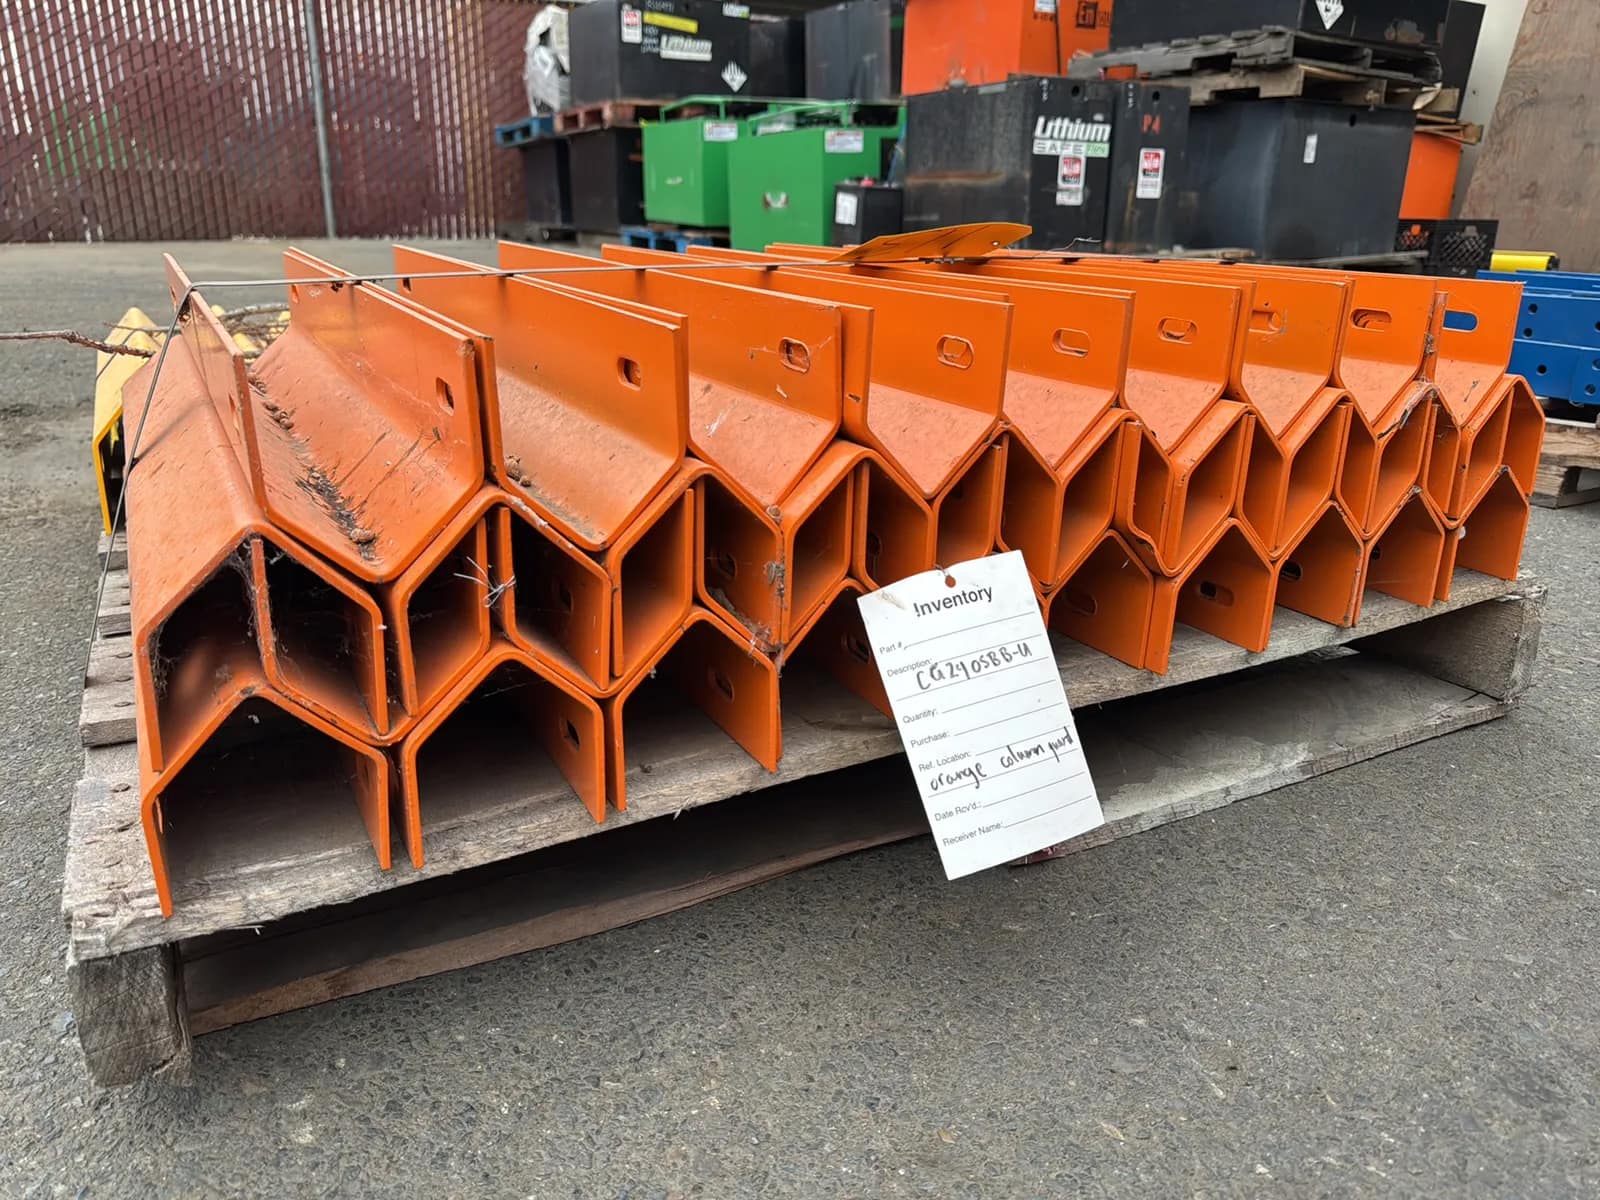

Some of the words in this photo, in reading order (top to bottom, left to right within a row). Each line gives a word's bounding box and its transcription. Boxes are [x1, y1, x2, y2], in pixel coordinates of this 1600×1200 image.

[1034, 115, 1111, 141] Lithium
[1142, 114, 1160, 134] P4
[1036, 141, 1084, 155] SAFE
[913, 586, 993, 618] Inventory
[879, 643, 896, 655] Part
[886, 658, 933, 677] Description:
[902, 708, 938, 724] Quantity:
[910, 730, 950, 748] Purchase:
[918, 760, 936, 772] Ref.
[936, 750, 972, 767] Location:
[930, 762, 987, 790] orange
[1000, 744, 1046, 768] column
[934, 810, 954, 822] Date
[942, 830, 977, 847] Receiver
[977, 820, 1004, 836] Name:
